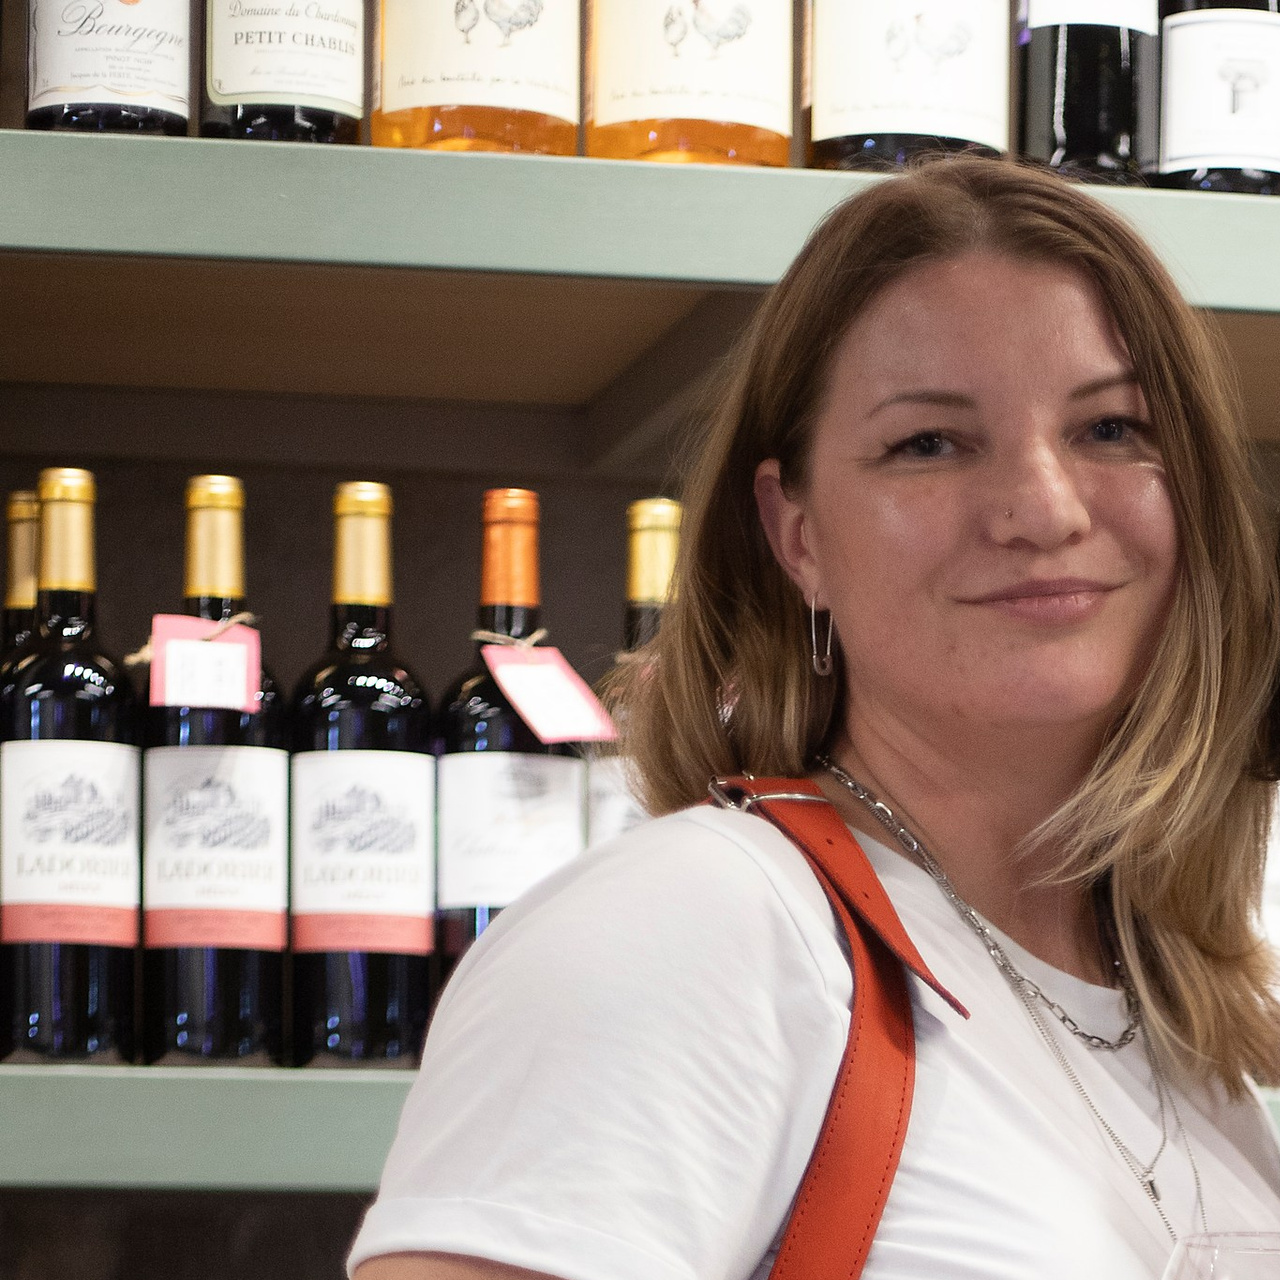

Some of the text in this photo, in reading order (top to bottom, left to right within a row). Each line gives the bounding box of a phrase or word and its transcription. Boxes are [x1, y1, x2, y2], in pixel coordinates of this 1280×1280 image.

[228, 0, 279, 19] Domaine
[285, 2, 299, 18] du
[233, 31, 287, 46] PETIT
[292, 32, 356, 56] CHABLIS
